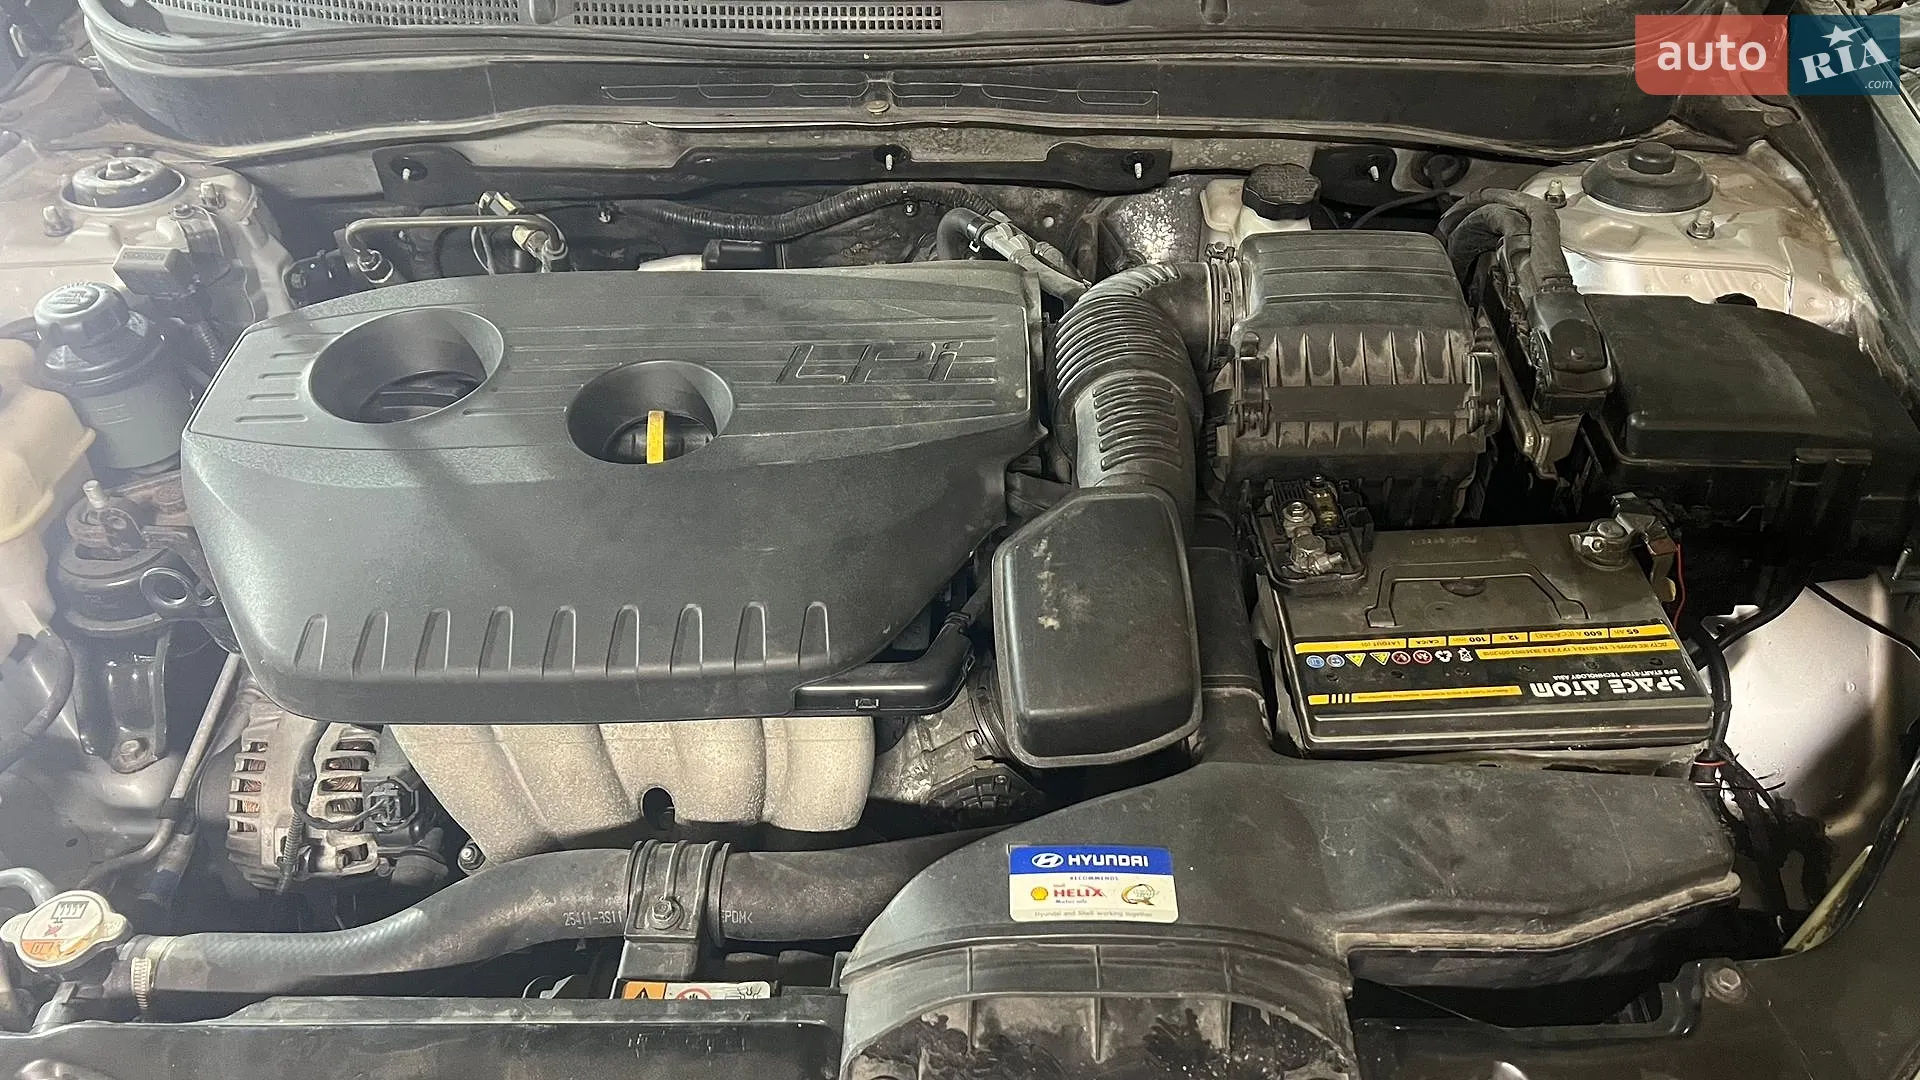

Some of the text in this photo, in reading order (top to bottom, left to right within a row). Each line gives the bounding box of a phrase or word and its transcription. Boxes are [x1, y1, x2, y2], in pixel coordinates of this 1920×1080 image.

[1571, 671, 1620, 680] TECHNOLOGY
[1529, 681, 1600, 698] ATOM
[1609, 675, 1685, 695] SPACE
[1068, 854, 1149, 867] HYUNDAI
[1053, 887, 1103, 898] HELIX
